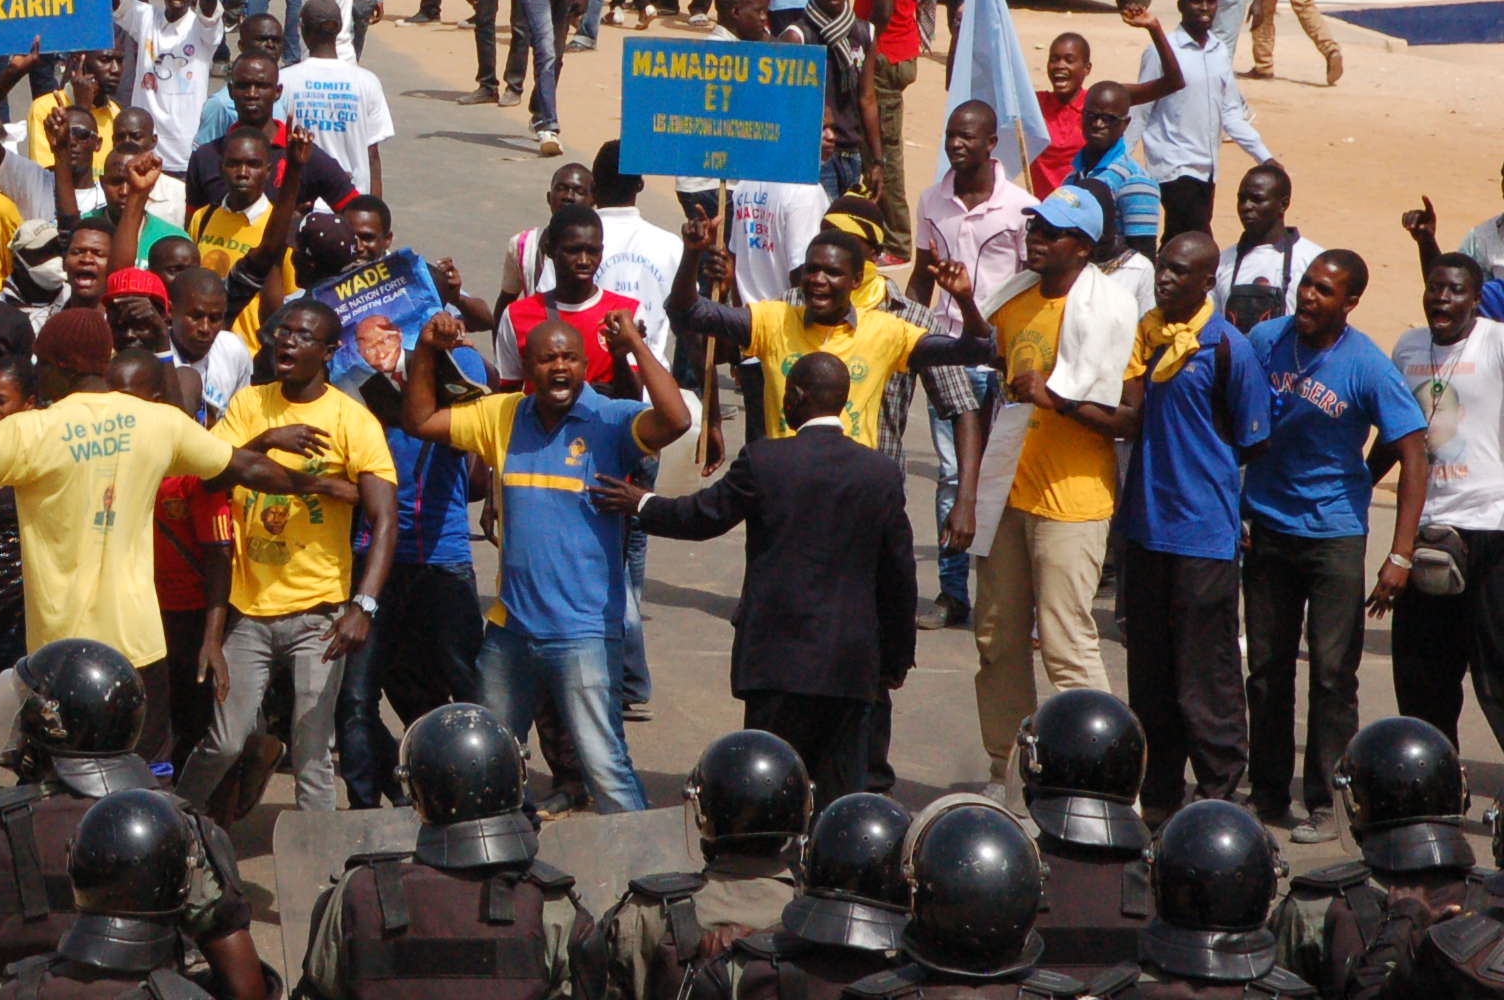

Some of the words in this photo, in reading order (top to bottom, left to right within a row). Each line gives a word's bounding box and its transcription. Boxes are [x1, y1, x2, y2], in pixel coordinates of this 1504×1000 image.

[632, 49, 750, 83] MAMADOU
[704, 83, 732, 112] ET
[201, 234, 252, 254] WADE
[335, 262, 391, 301] WADE
[348, 290, 379, 308] NATION
[379, 276, 408, 294] FORTE
[352, 299, 382, 317] DESTIN
[382, 287, 407, 303] CLAIR
[61, 422, 87, 442] Je
[91, 413, 136, 436] vote
[69, 433, 131, 462] WADE
